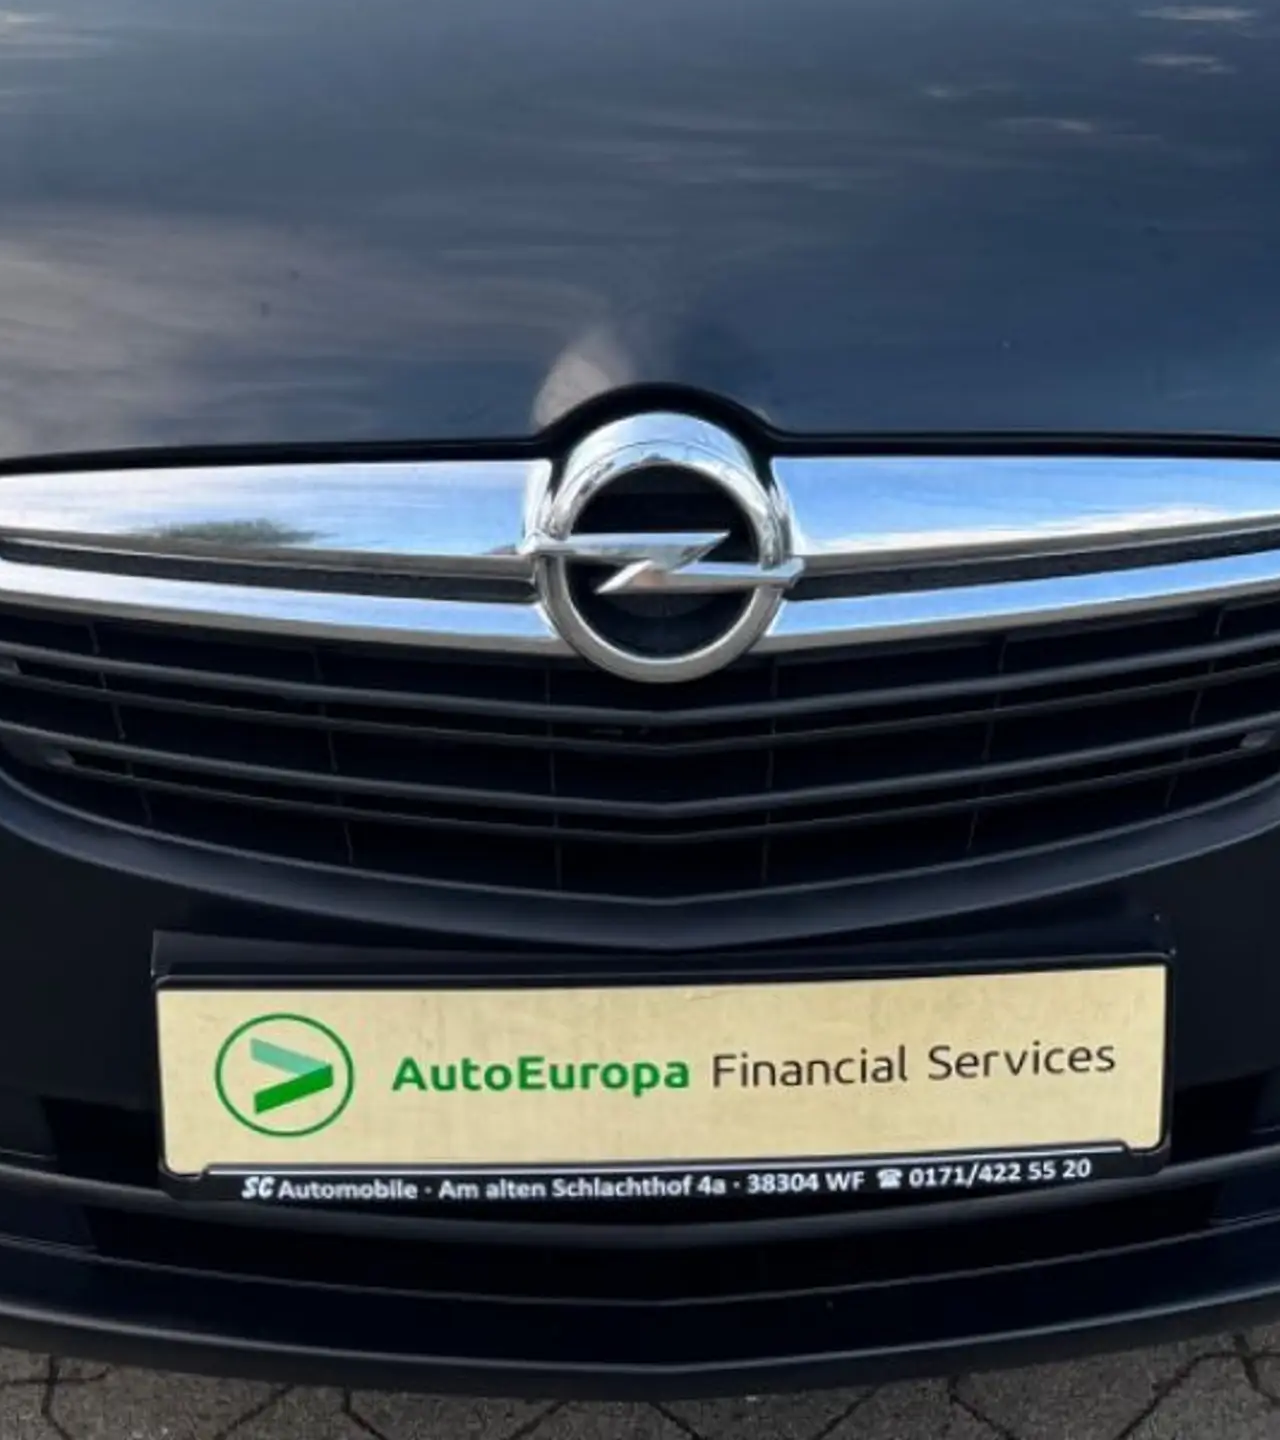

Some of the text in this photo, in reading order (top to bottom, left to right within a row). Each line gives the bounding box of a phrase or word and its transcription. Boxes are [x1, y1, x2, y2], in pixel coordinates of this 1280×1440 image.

[392, 1041, 1116, 1097] AutoEuropa Financial Services
[241, 1157, 1092, 1199] SC Automobile Am alten Schlachthof 4a 38304 WF 0171/422 55 20
